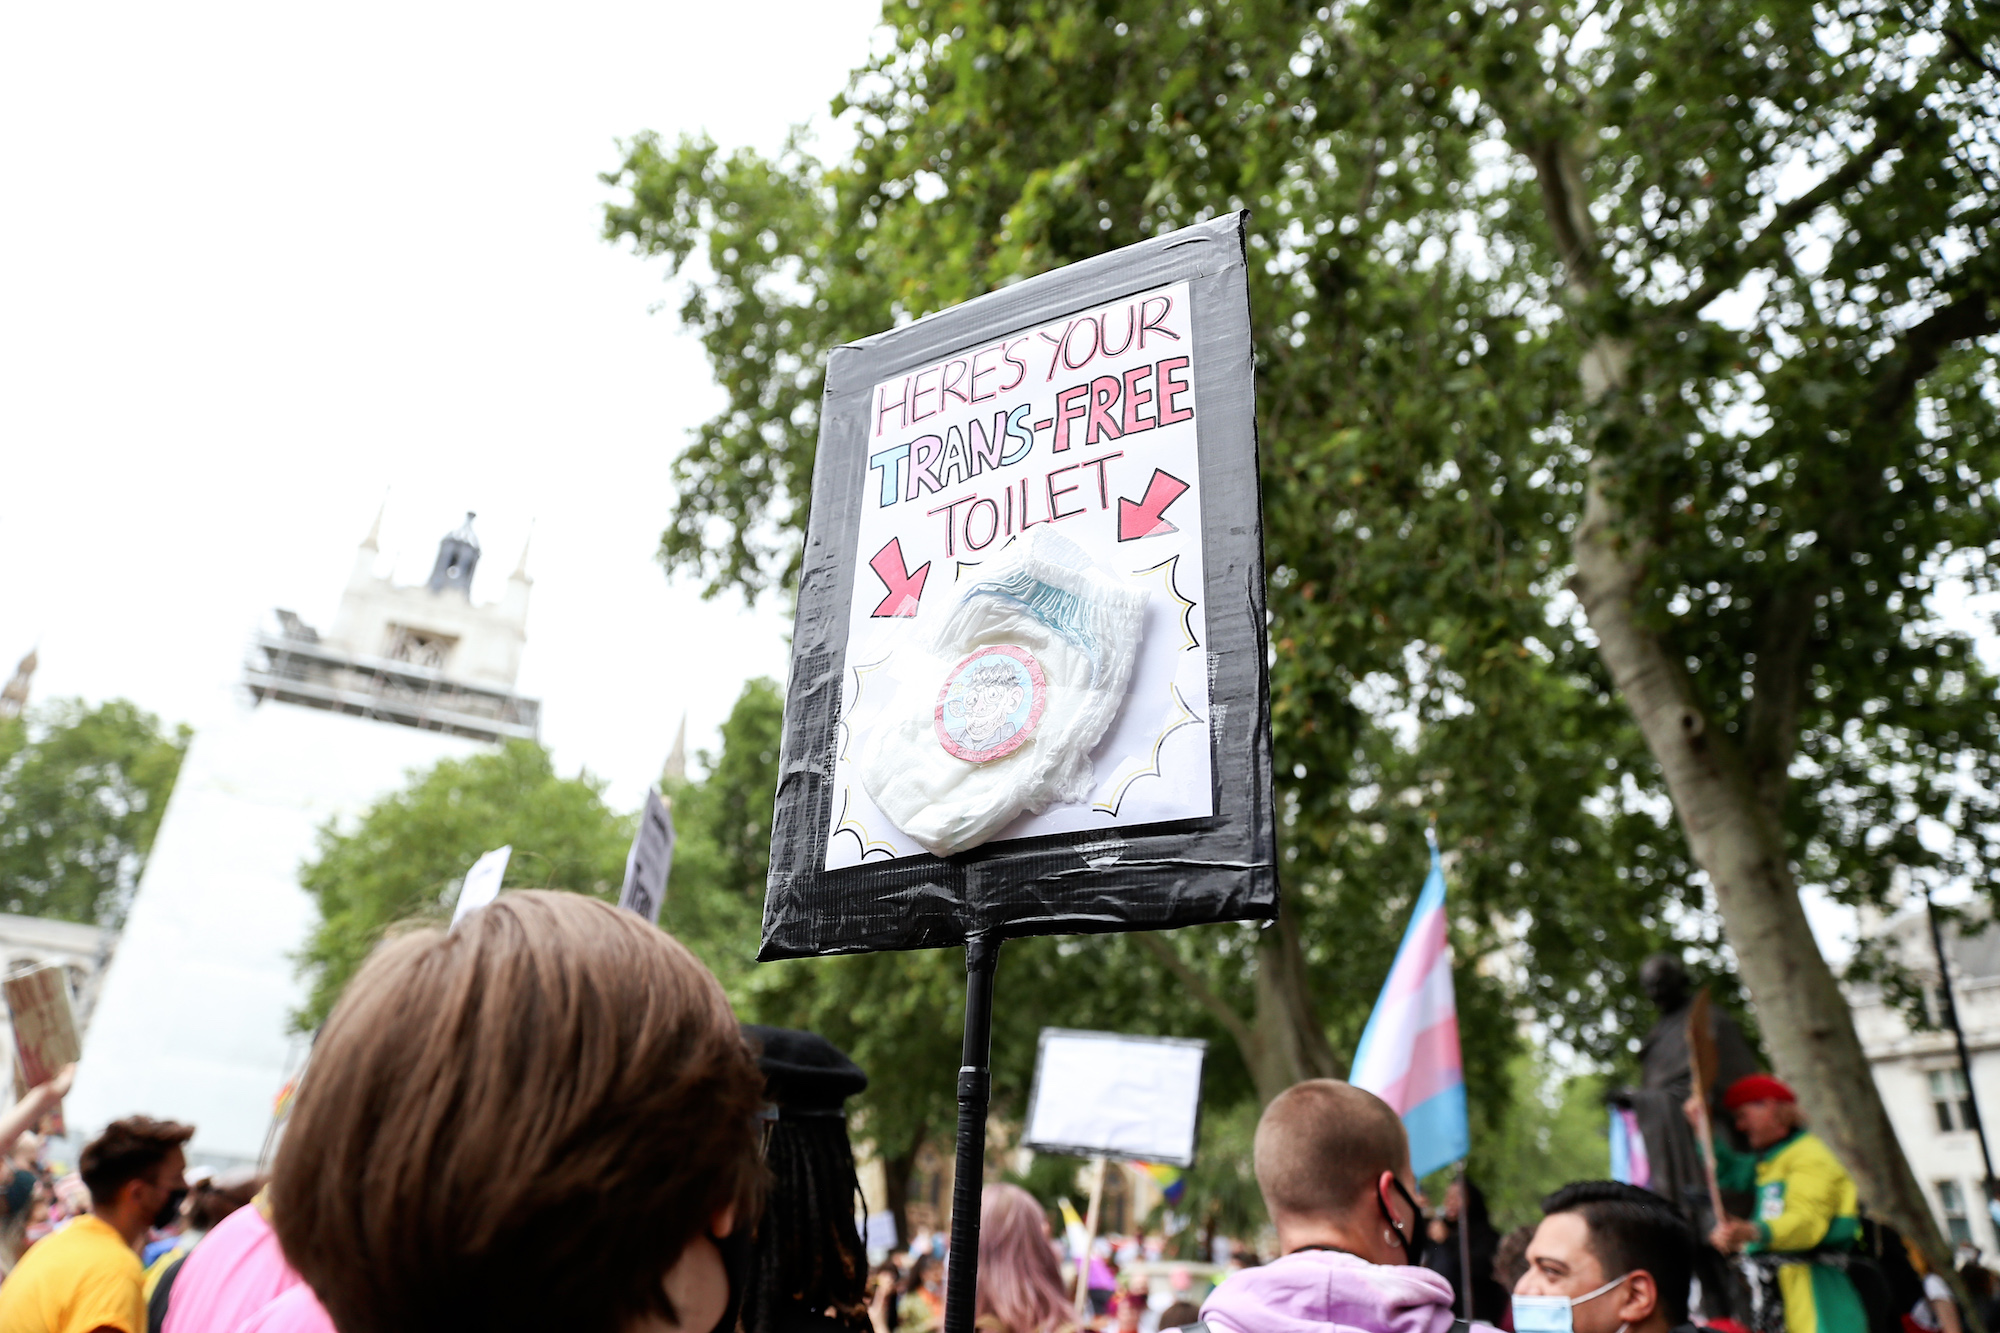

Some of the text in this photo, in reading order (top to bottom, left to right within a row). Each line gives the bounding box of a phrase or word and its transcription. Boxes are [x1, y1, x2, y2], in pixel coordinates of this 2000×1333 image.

[870, 356, 1194, 508] TRANS-FREE
[876, 295, 1180, 436] HERE'S YOUR
[927, 450, 1124, 558] TOILET
